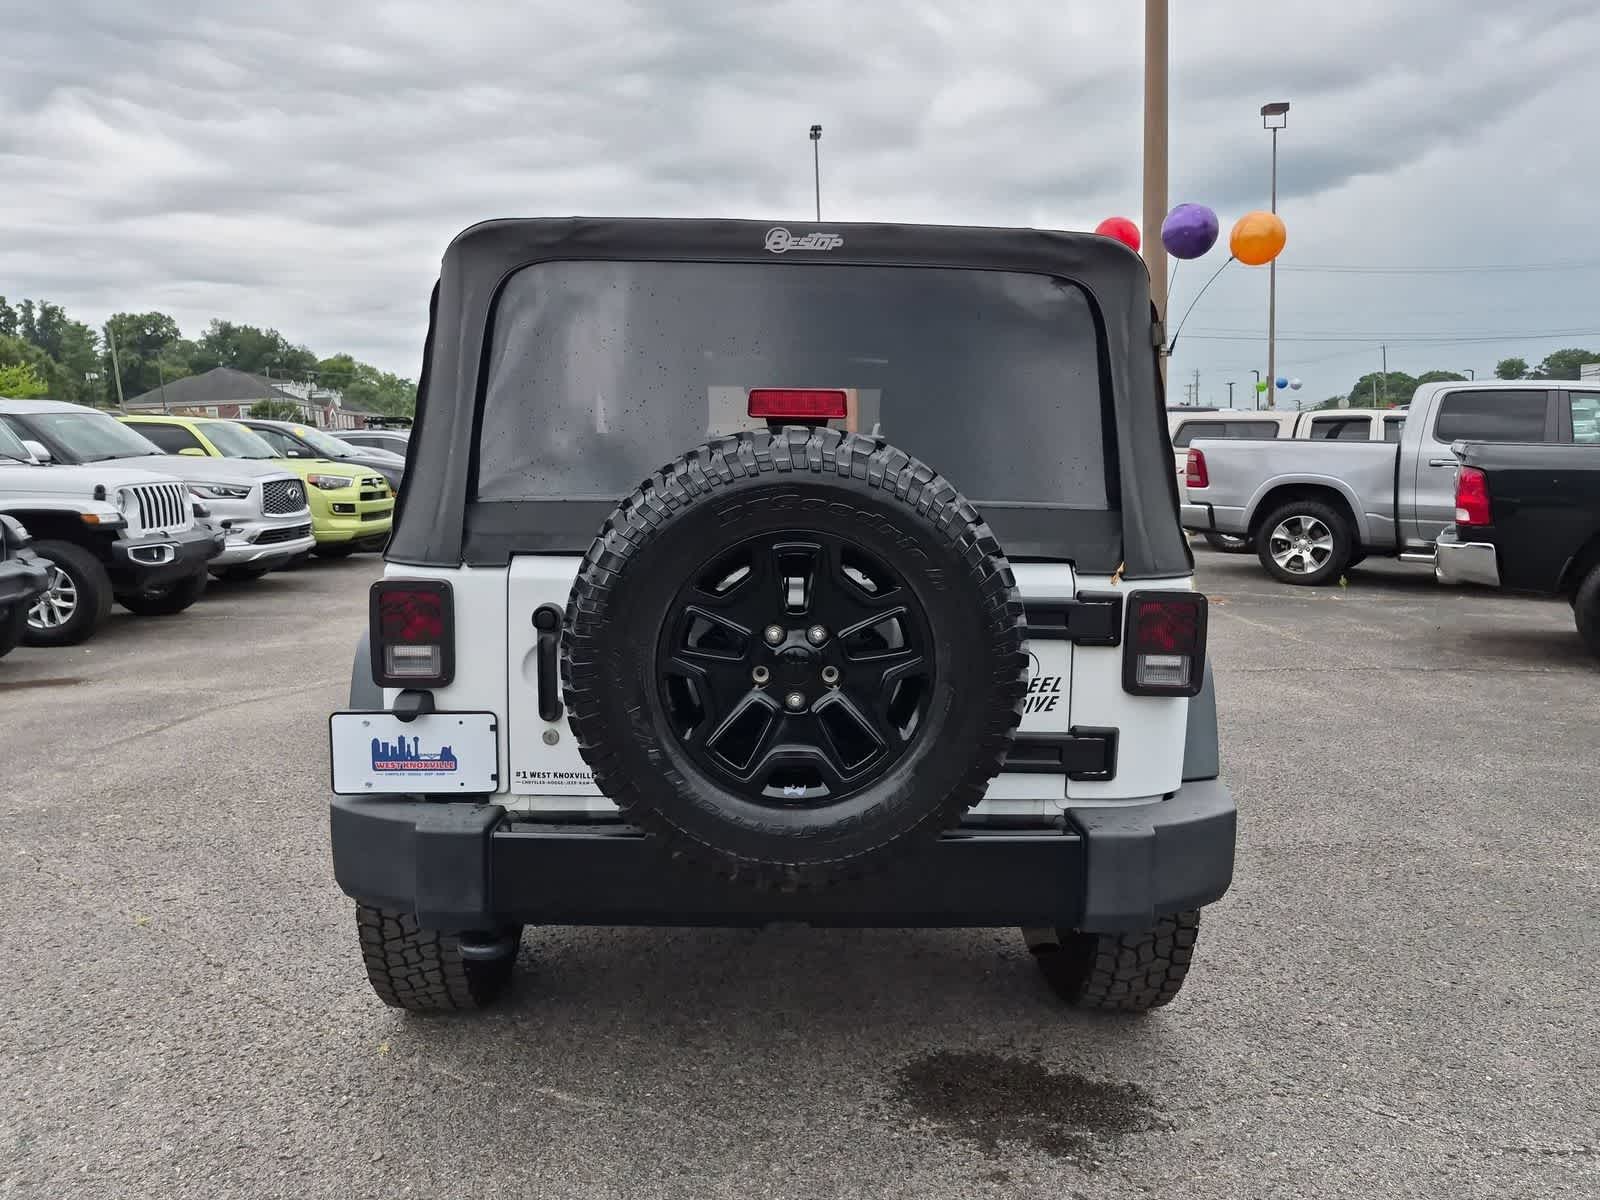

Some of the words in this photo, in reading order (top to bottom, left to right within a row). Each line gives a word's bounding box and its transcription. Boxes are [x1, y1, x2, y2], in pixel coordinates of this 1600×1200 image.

[1027, 677, 1061, 693] EEL
[1024, 696, 1060, 714] IVE
[375, 761, 401, 769] WEST
[403, 761, 455, 769] KNOXVILLE
[516, 771, 528, 779] #1
[529, 771, 551, 779] WEST
